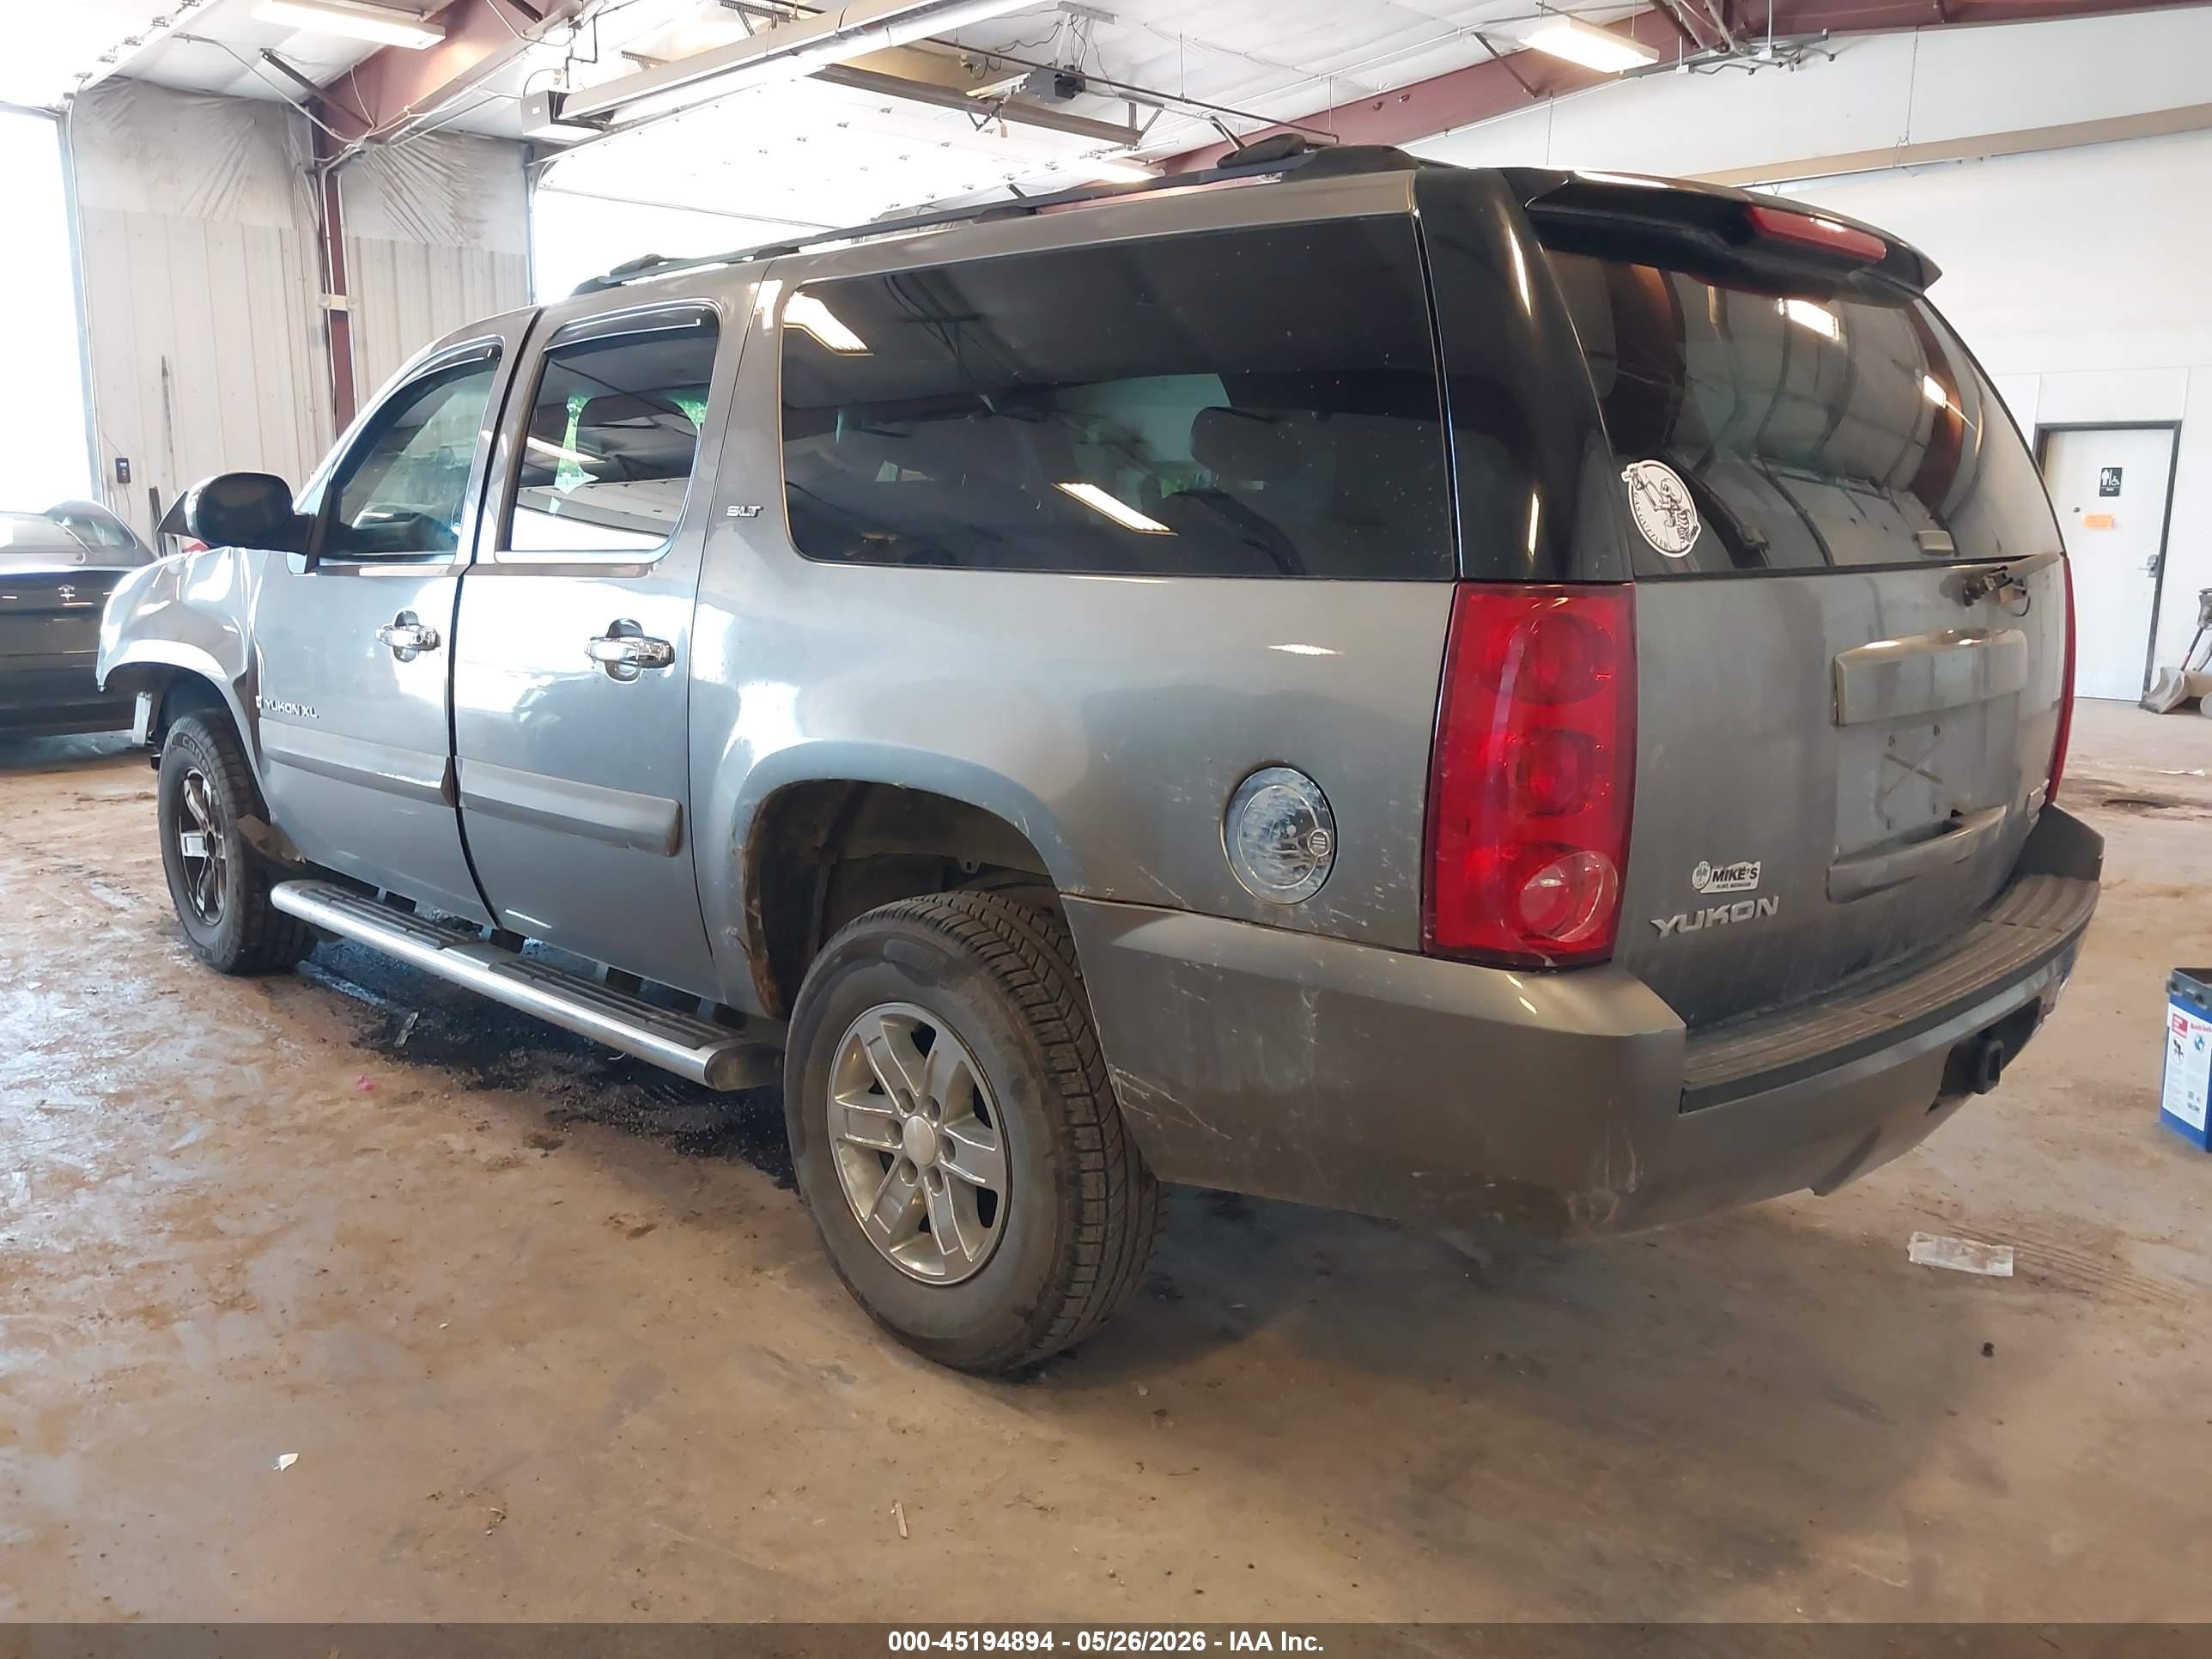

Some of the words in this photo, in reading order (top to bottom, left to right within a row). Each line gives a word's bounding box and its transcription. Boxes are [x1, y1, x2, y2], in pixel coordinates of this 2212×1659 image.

[726, 505, 762, 517] SLT
[264, 699, 300, 715] YUKON
[301, 705, 318, 718] XL
[1712, 867, 1759, 883] MIKE'S
[1650, 896, 1779, 939] YUKON
